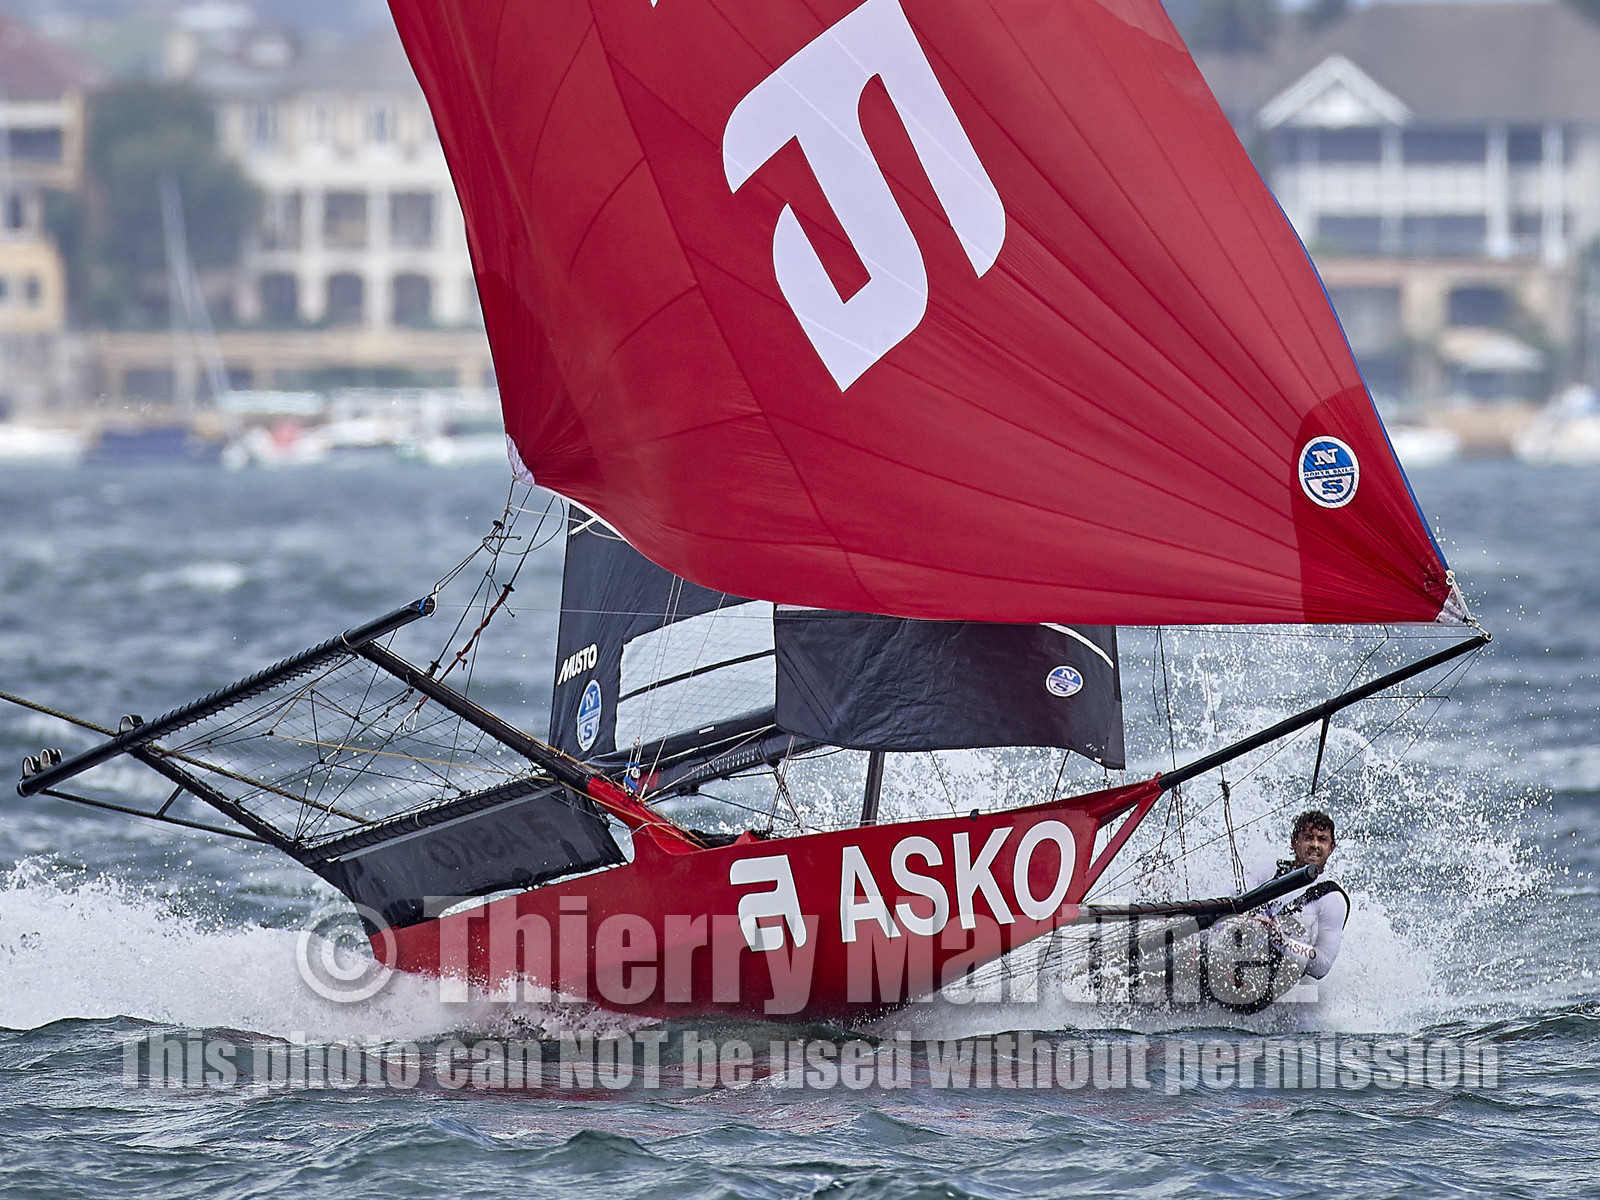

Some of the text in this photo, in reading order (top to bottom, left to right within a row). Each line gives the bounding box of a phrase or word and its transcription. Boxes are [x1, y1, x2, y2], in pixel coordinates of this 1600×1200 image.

[1311, 447, 1339, 466] N
[1322, 478, 1344, 495] S
[557, 643, 598, 686] MUSTO
[584, 690, 598, 711] N
[583, 722, 593, 741] S
[840, 820, 1077, 943] ASKO
